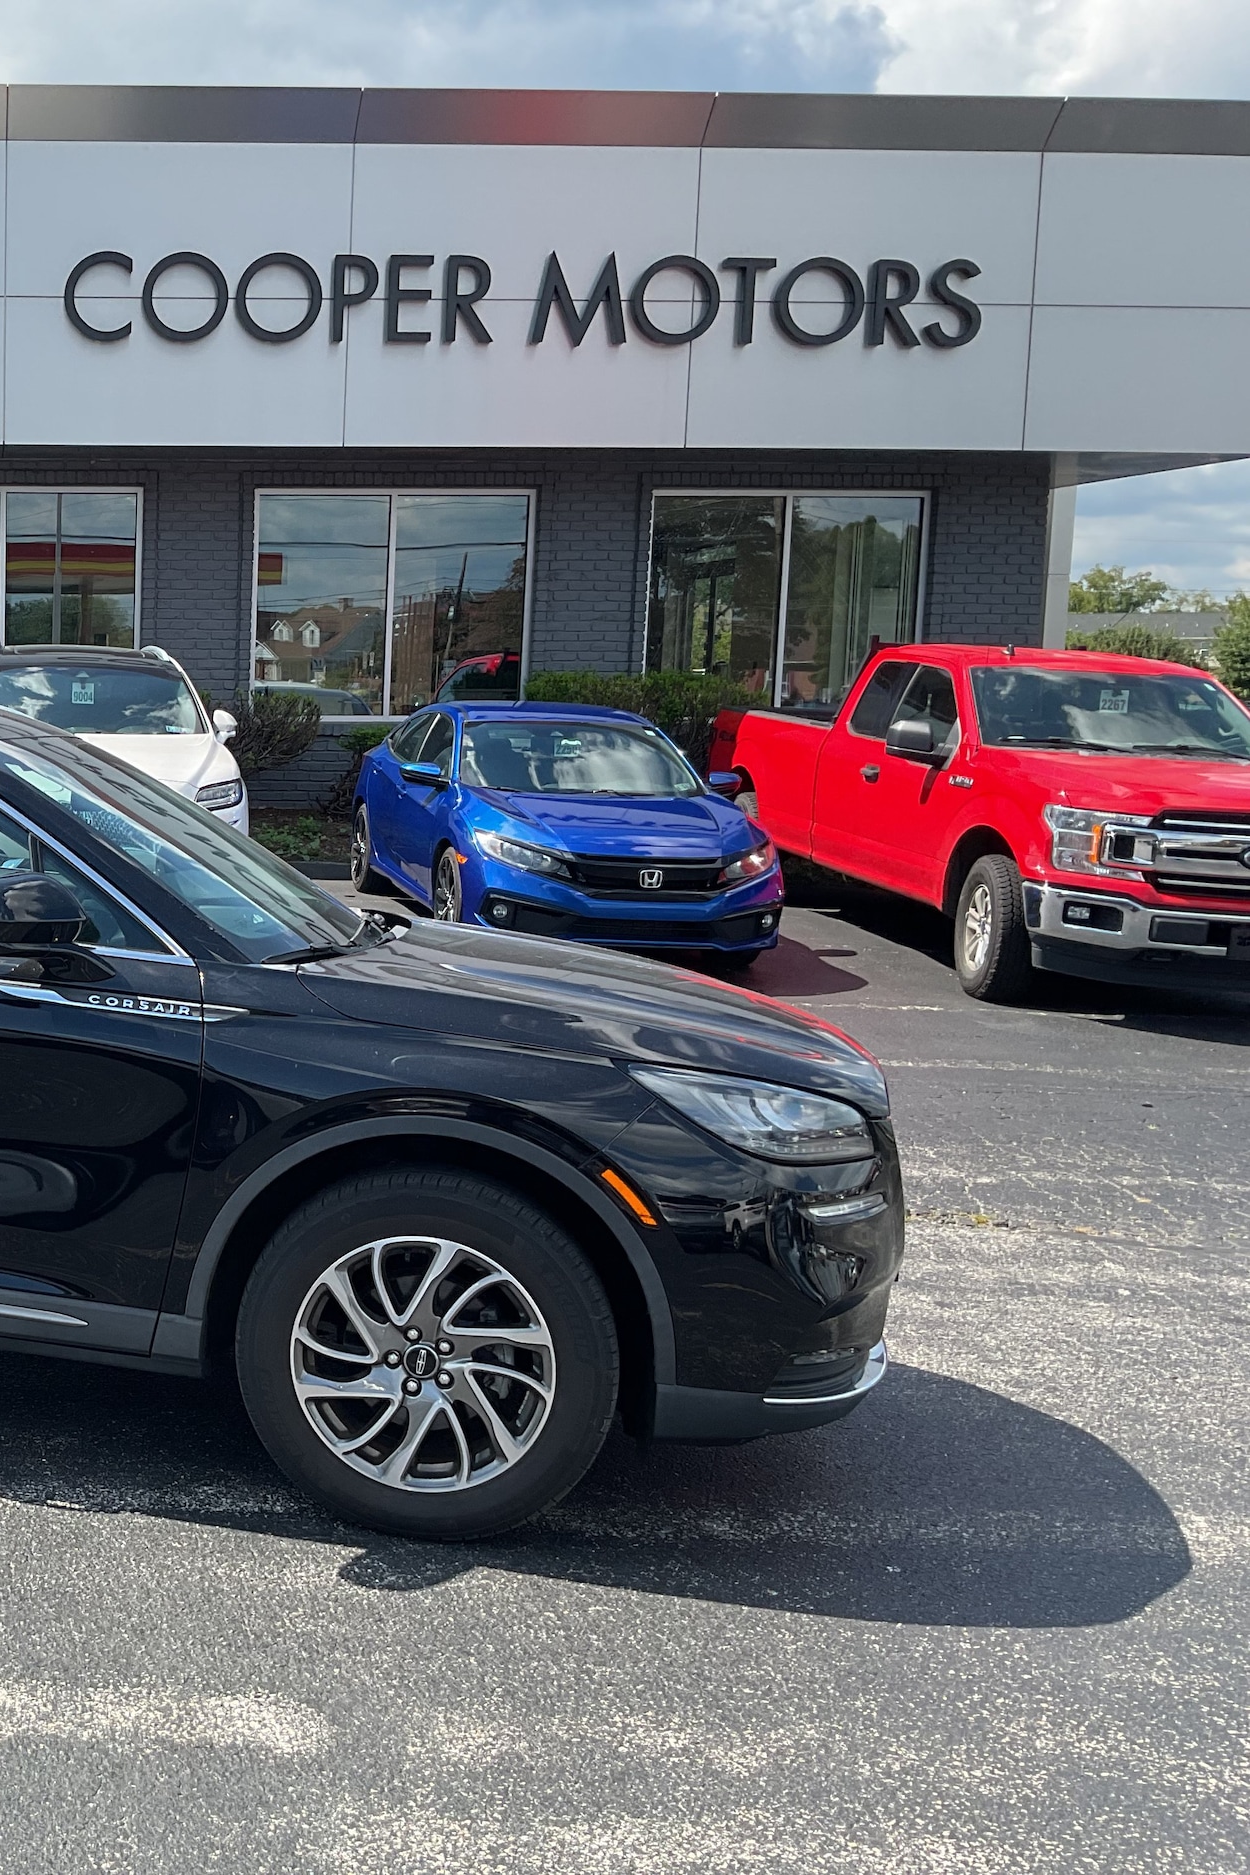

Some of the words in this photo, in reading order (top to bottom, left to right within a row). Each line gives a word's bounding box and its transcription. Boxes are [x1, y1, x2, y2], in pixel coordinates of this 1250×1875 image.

[64, 251, 493, 342] COOPER
[526, 250, 982, 347] MOTORS
[73, 690, 93, 703] 9004
[1101, 699, 1126, 711] 2267
[88, 995, 192, 1016] CORSAIR
